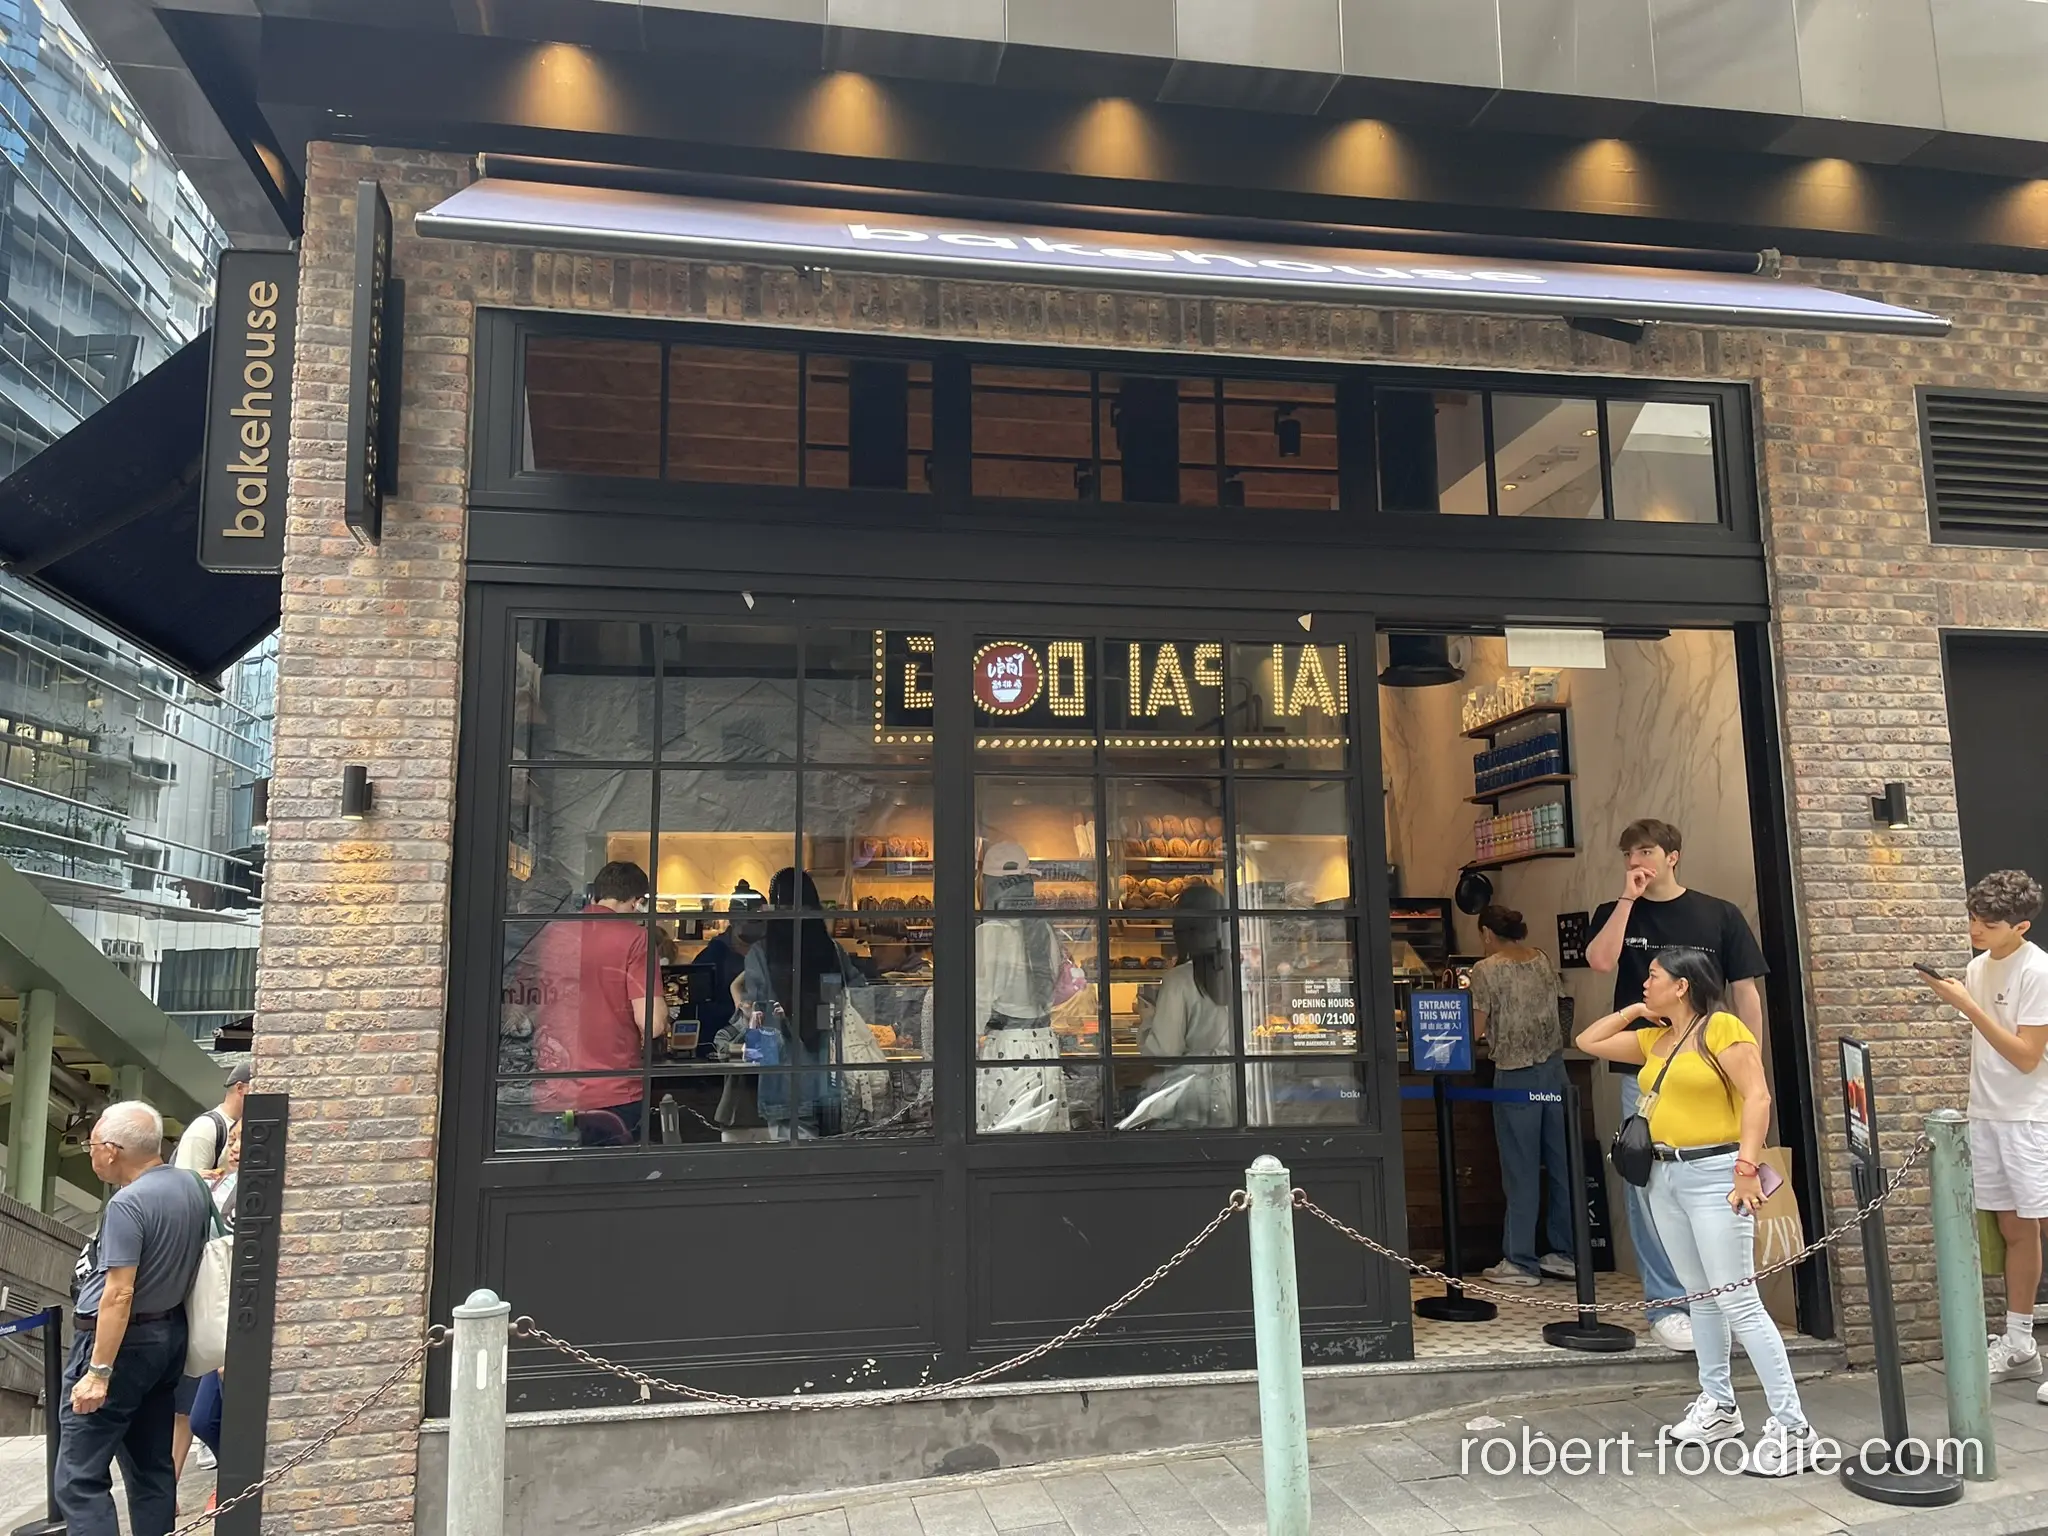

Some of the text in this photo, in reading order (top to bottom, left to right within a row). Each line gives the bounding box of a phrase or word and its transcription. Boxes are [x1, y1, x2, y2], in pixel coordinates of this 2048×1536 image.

[847, 223, 1547, 285] bakehouse
[222, 280, 279, 538] bakehouse
[1291, 998, 1355, 1008] OPENING HOURS
[1419, 1000, 1461, 1010] ENTRANCE
[1292, 1012, 1355, 1025] 08:00/21:00
[1419, 1010, 1461, 1020] THIS WAY!
[236, 1118, 280, 1333] bakehouse
